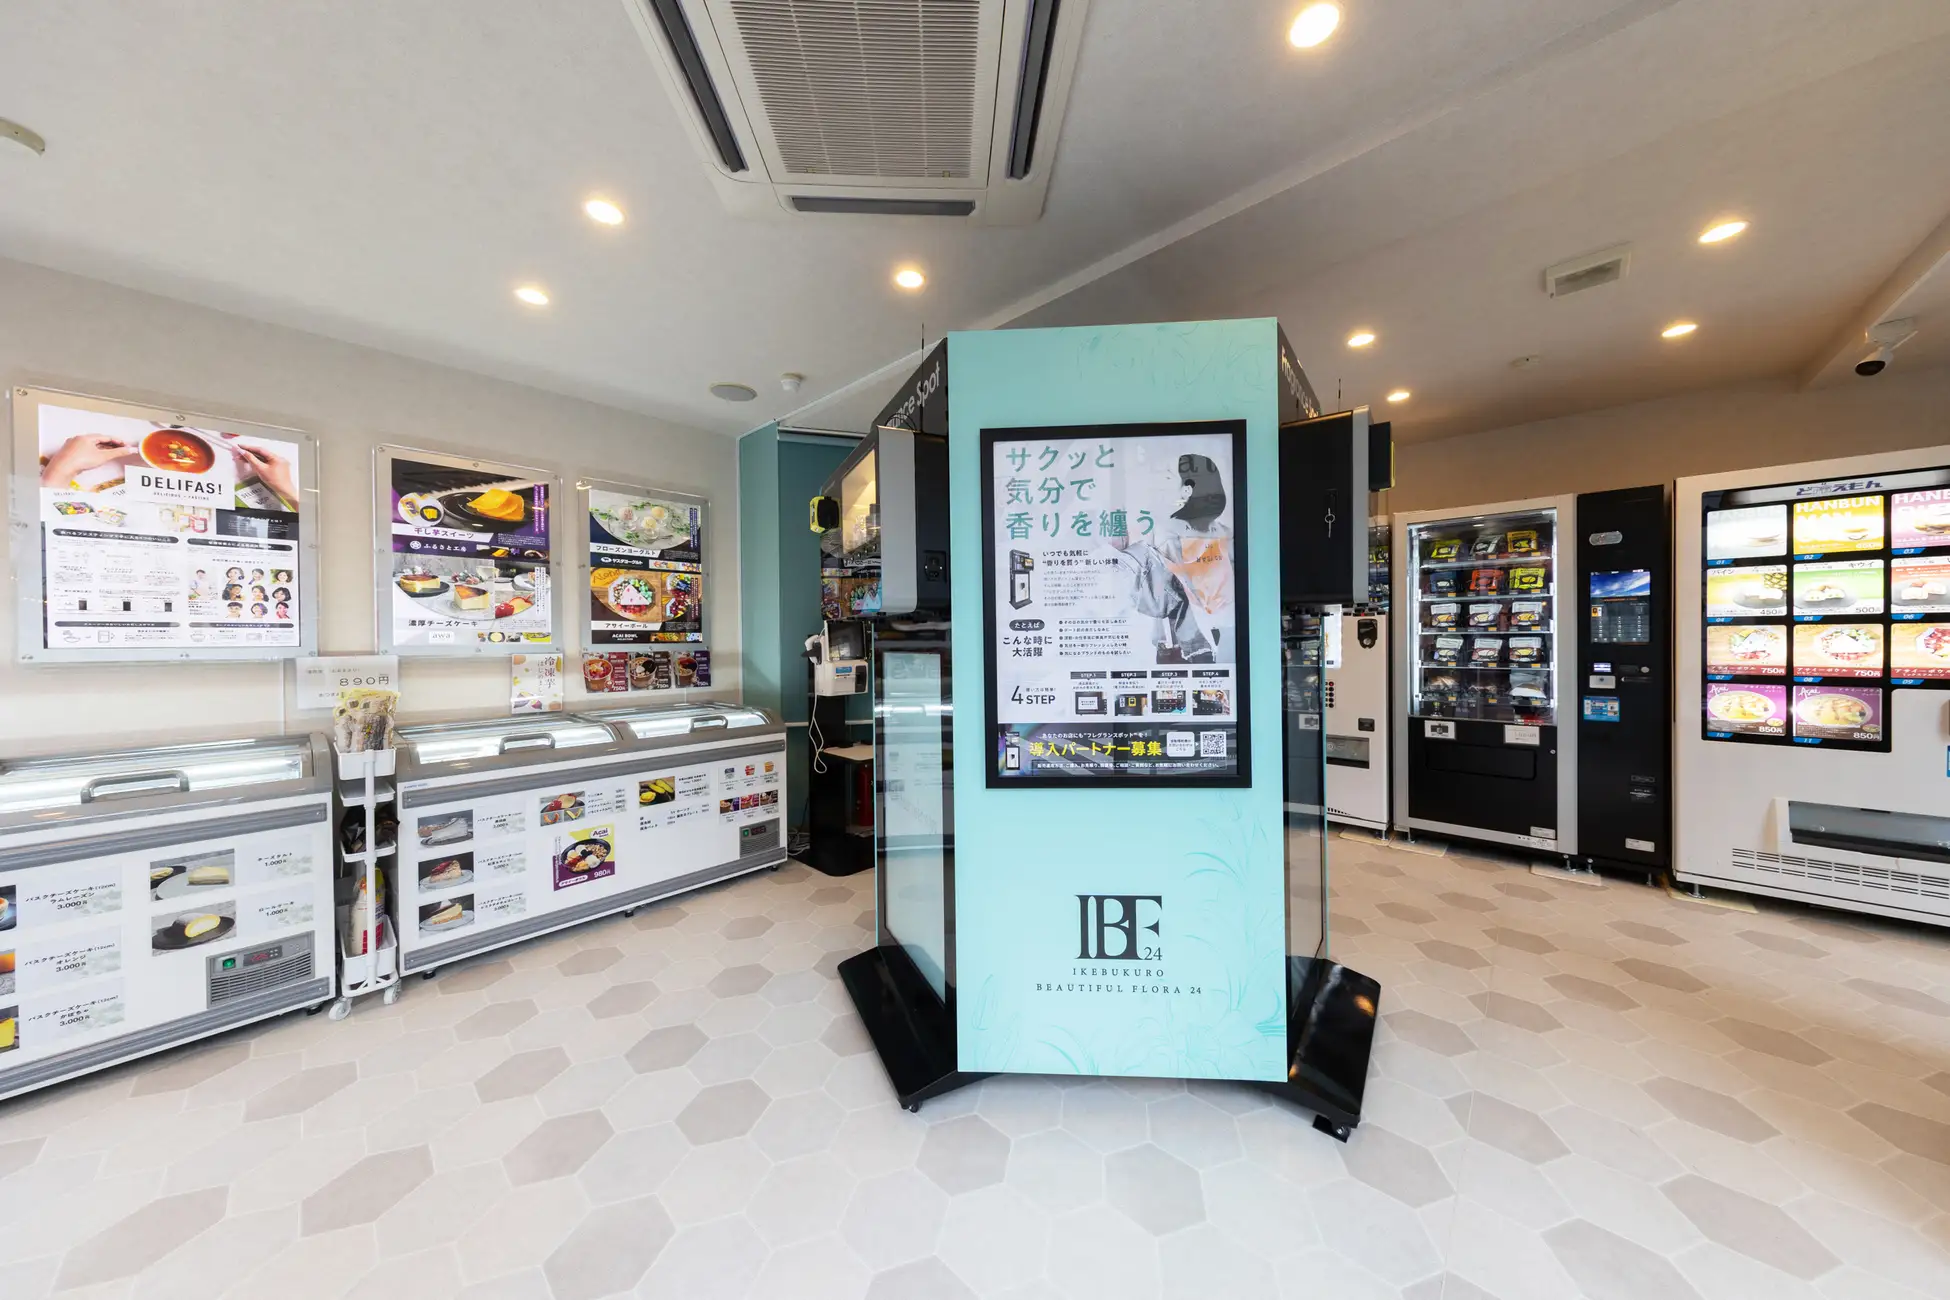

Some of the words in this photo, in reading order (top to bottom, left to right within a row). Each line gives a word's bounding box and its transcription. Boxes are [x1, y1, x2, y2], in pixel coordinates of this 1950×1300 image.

[916, 360, 940, 407] Spot
[1006, 444, 1114, 472] サクッと
[141, 475, 222, 495] DELIFAS!
[1006, 477, 1096, 505] 気分で
[1796, 495, 1880, 513] HANBUN
[1006, 509, 1154, 540] 香りを纏う
[414, 527, 474, 539] 干し芋スイーツ
[596, 545, 656, 555] フローズンヨーグルト
[408, 619, 478, 627] 濃厚チーズケーキ
[1003, 635, 1053, 645] こんな時に
[1012, 646, 1043, 657] 大活躍
[1853, 669, 1881, 677] 750円
[340, 675, 389, 687] 890円
[1011, 685, 1024, 704] 4
[1026, 695, 1056, 705] STEP
[1029, 741, 1162, 756] 導入パートナー募集
[592, 828, 608, 837] Acai
[258, 852, 292, 861] チーズタルト
[594, 869, 611, 878] 980円
[51, 892, 95, 904] ラムレーズン
[259, 901, 294, 912] ロールケーキ
[56, 954, 86, 965] オレンジ
[1143, 946, 1162, 961] 24
[1073, 967, 1164, 977] IKEBUKURO
[1036, 983, 1123, 993] BEAUTIFUL
[1132, 985, 1181, 994] FLORA
[1190, 986, 1202, 994] 24
[60, 1008, 89, 1020] かぼちゃ
